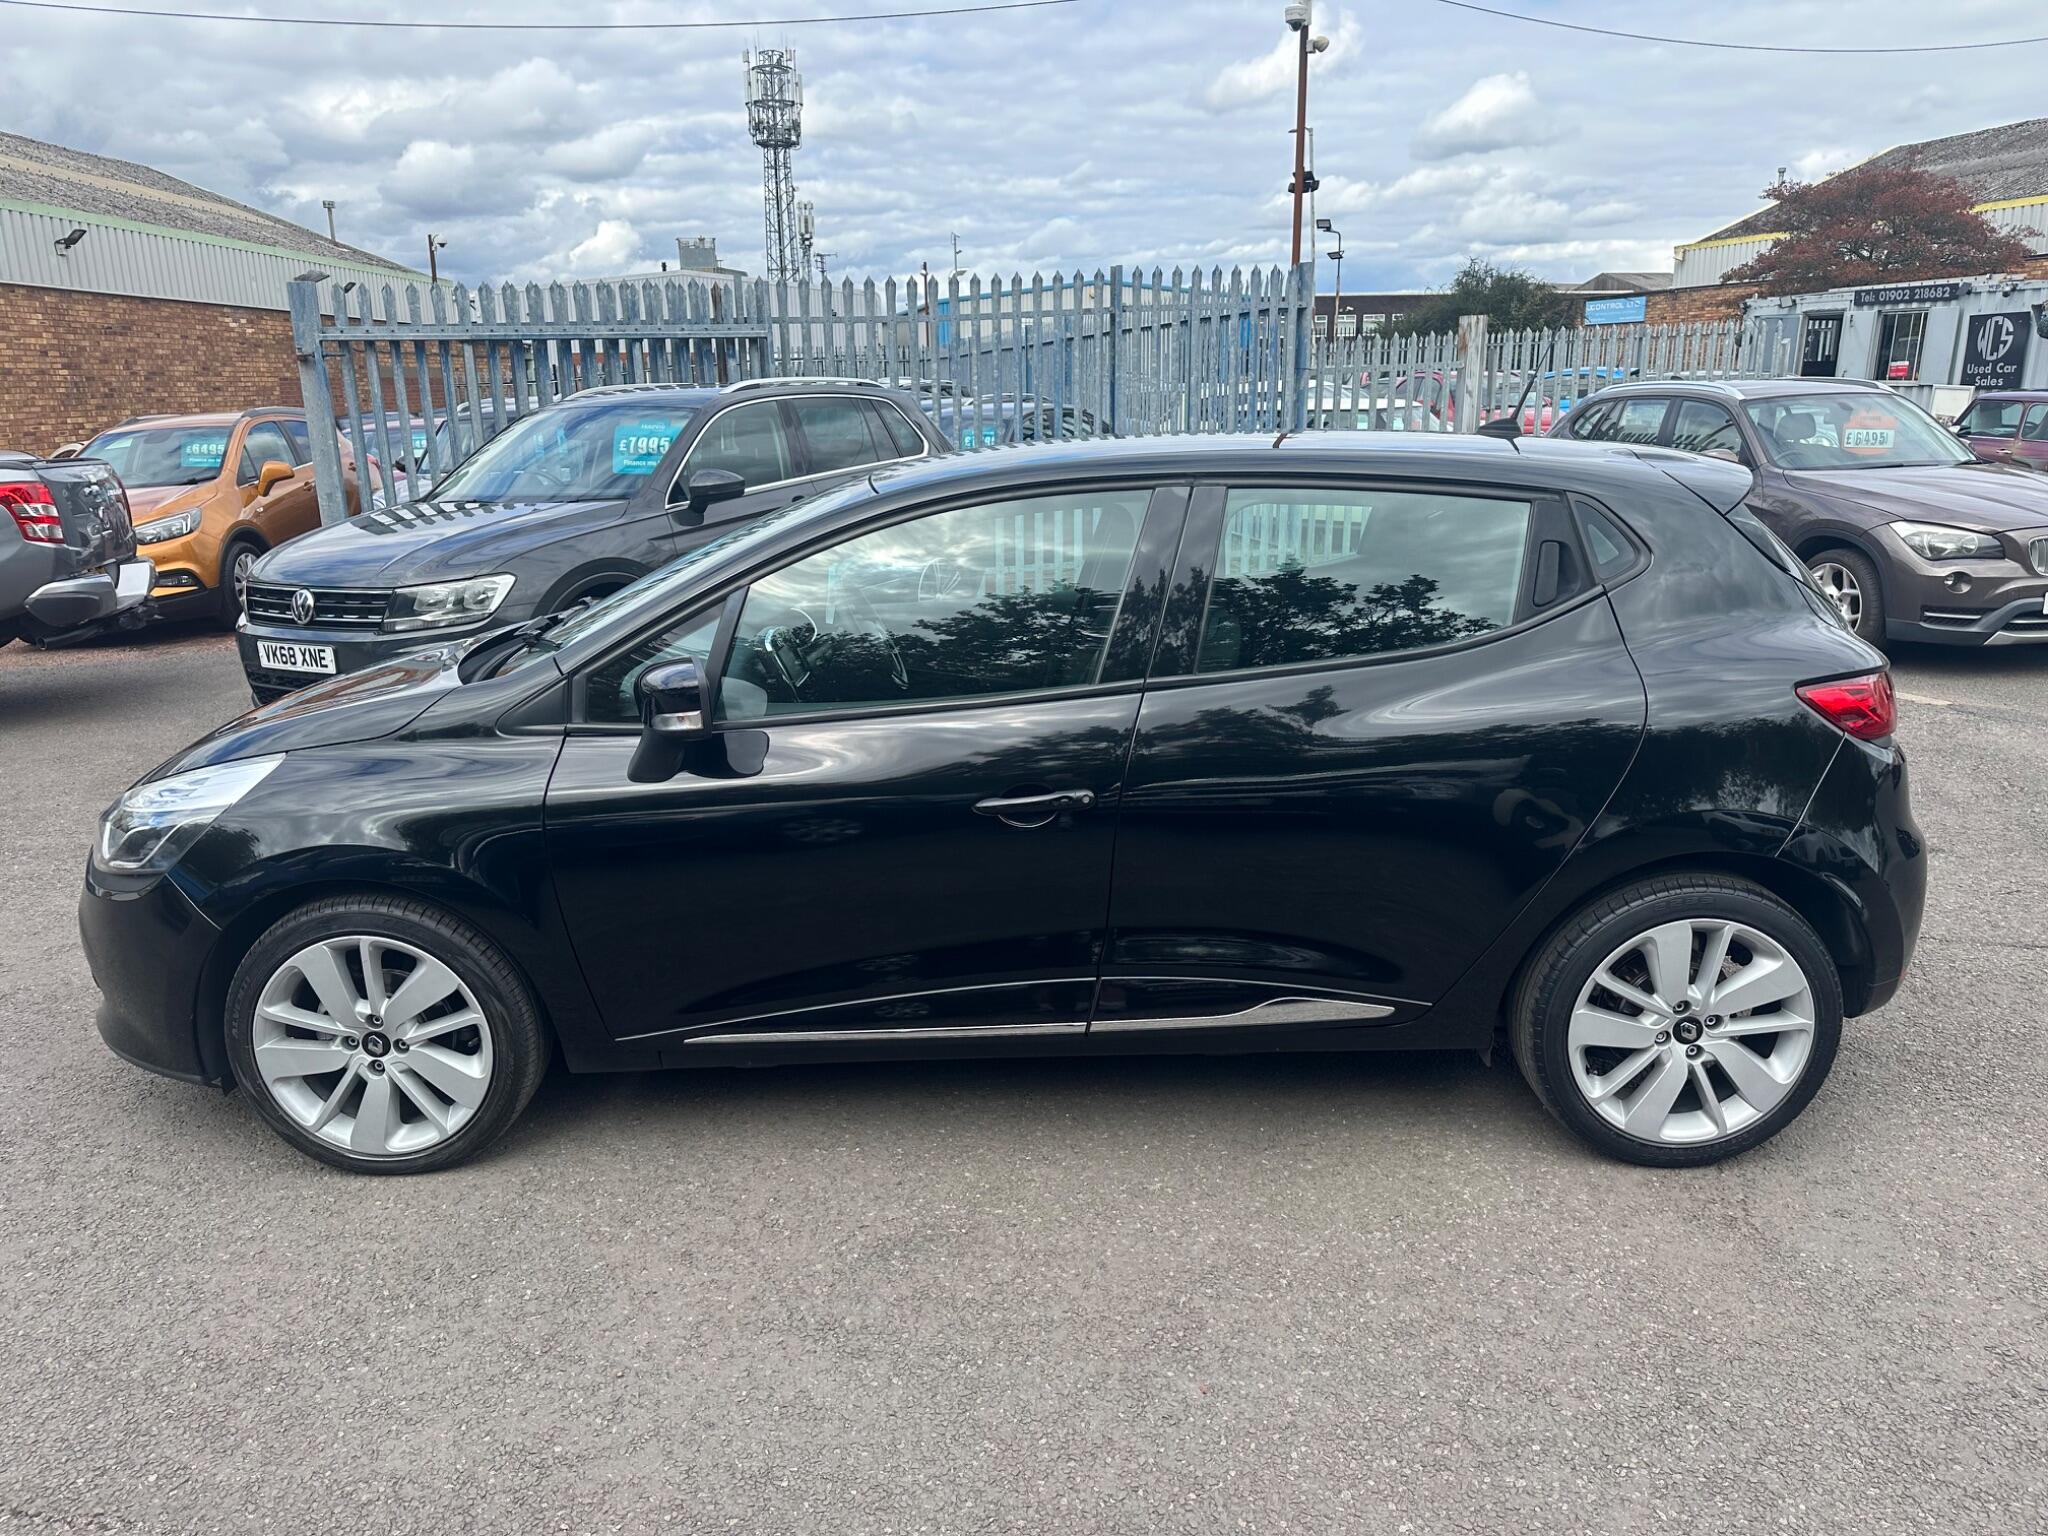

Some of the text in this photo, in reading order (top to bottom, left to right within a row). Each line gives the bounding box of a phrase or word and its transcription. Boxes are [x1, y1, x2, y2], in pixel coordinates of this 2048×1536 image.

[1861, 286, 1950, 302] Tel: 01902 218682
[1966, 362, 2017, 374] Used Car
[1974, 375, 2004, 386] Sales
[185, 443, 225, 455] £6495
[619, 436, 670, 454] £7995
[262, 644, 328, 668] VK68 XNE
